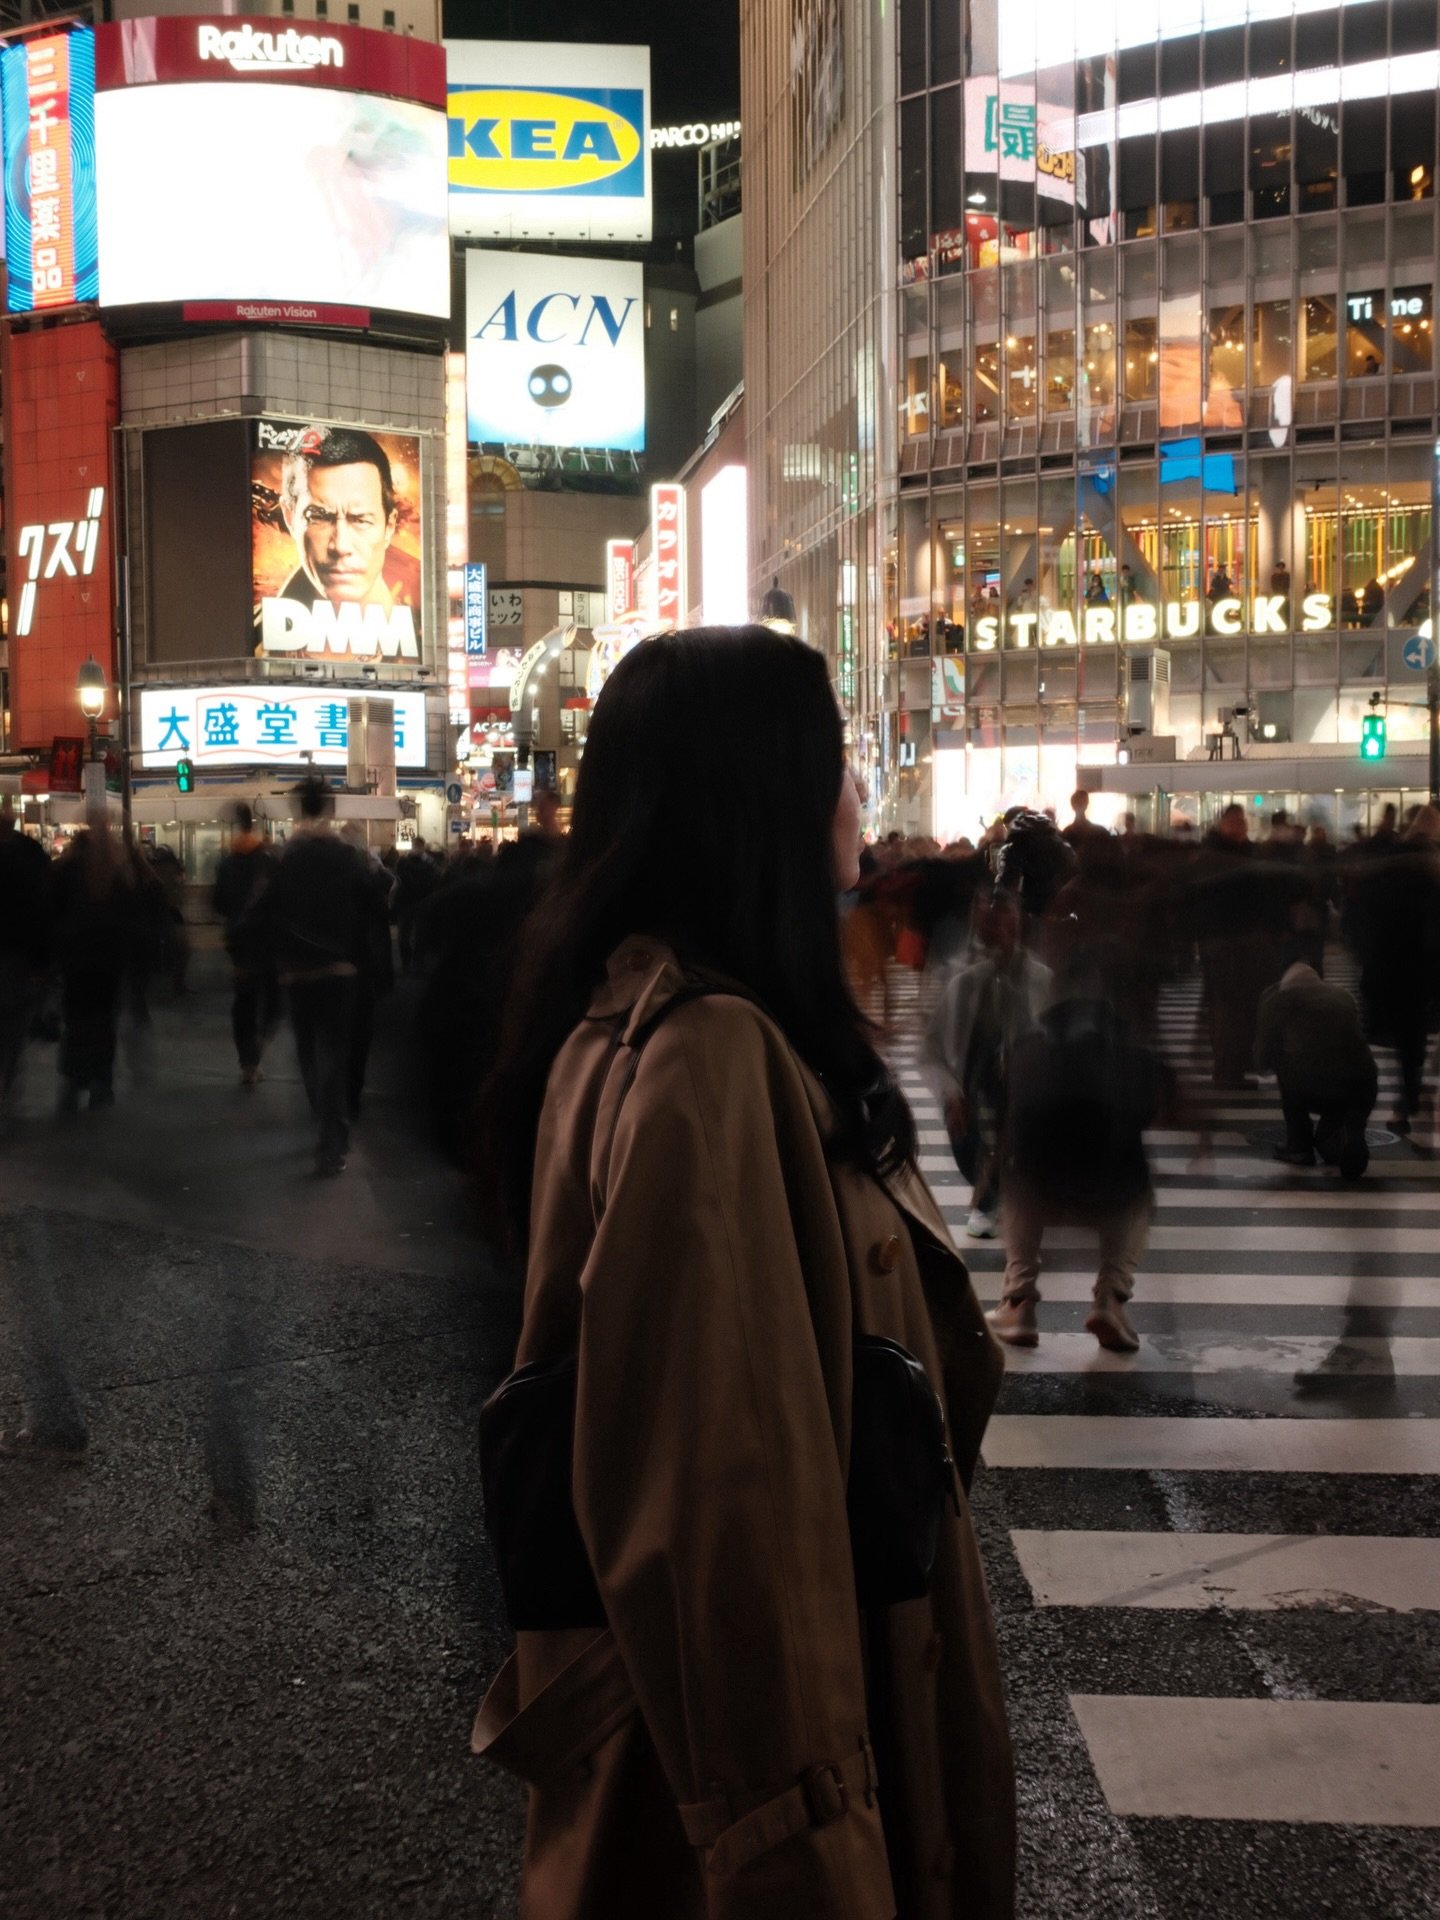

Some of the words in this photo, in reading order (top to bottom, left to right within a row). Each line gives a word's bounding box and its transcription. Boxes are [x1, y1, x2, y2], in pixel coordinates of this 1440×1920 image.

[197, 24, 344, 70] Rakuten
[448, 118, 623, 162] KEA
[651, 123, 710, 149] PARCO
[28, 46, 63, 291] 三千里薬品
[236, 304, 282, 319] Rakuten
[283, 305, 318, 319] Vision
[471, 288, 639, 349] ACN
[17, 487, 104, 636] クスリ
[658, 502, 678, 622] カラオケ
[261, 597, 418, 657] DMM
[975, 594, 1333, 650] STARBUCKS
